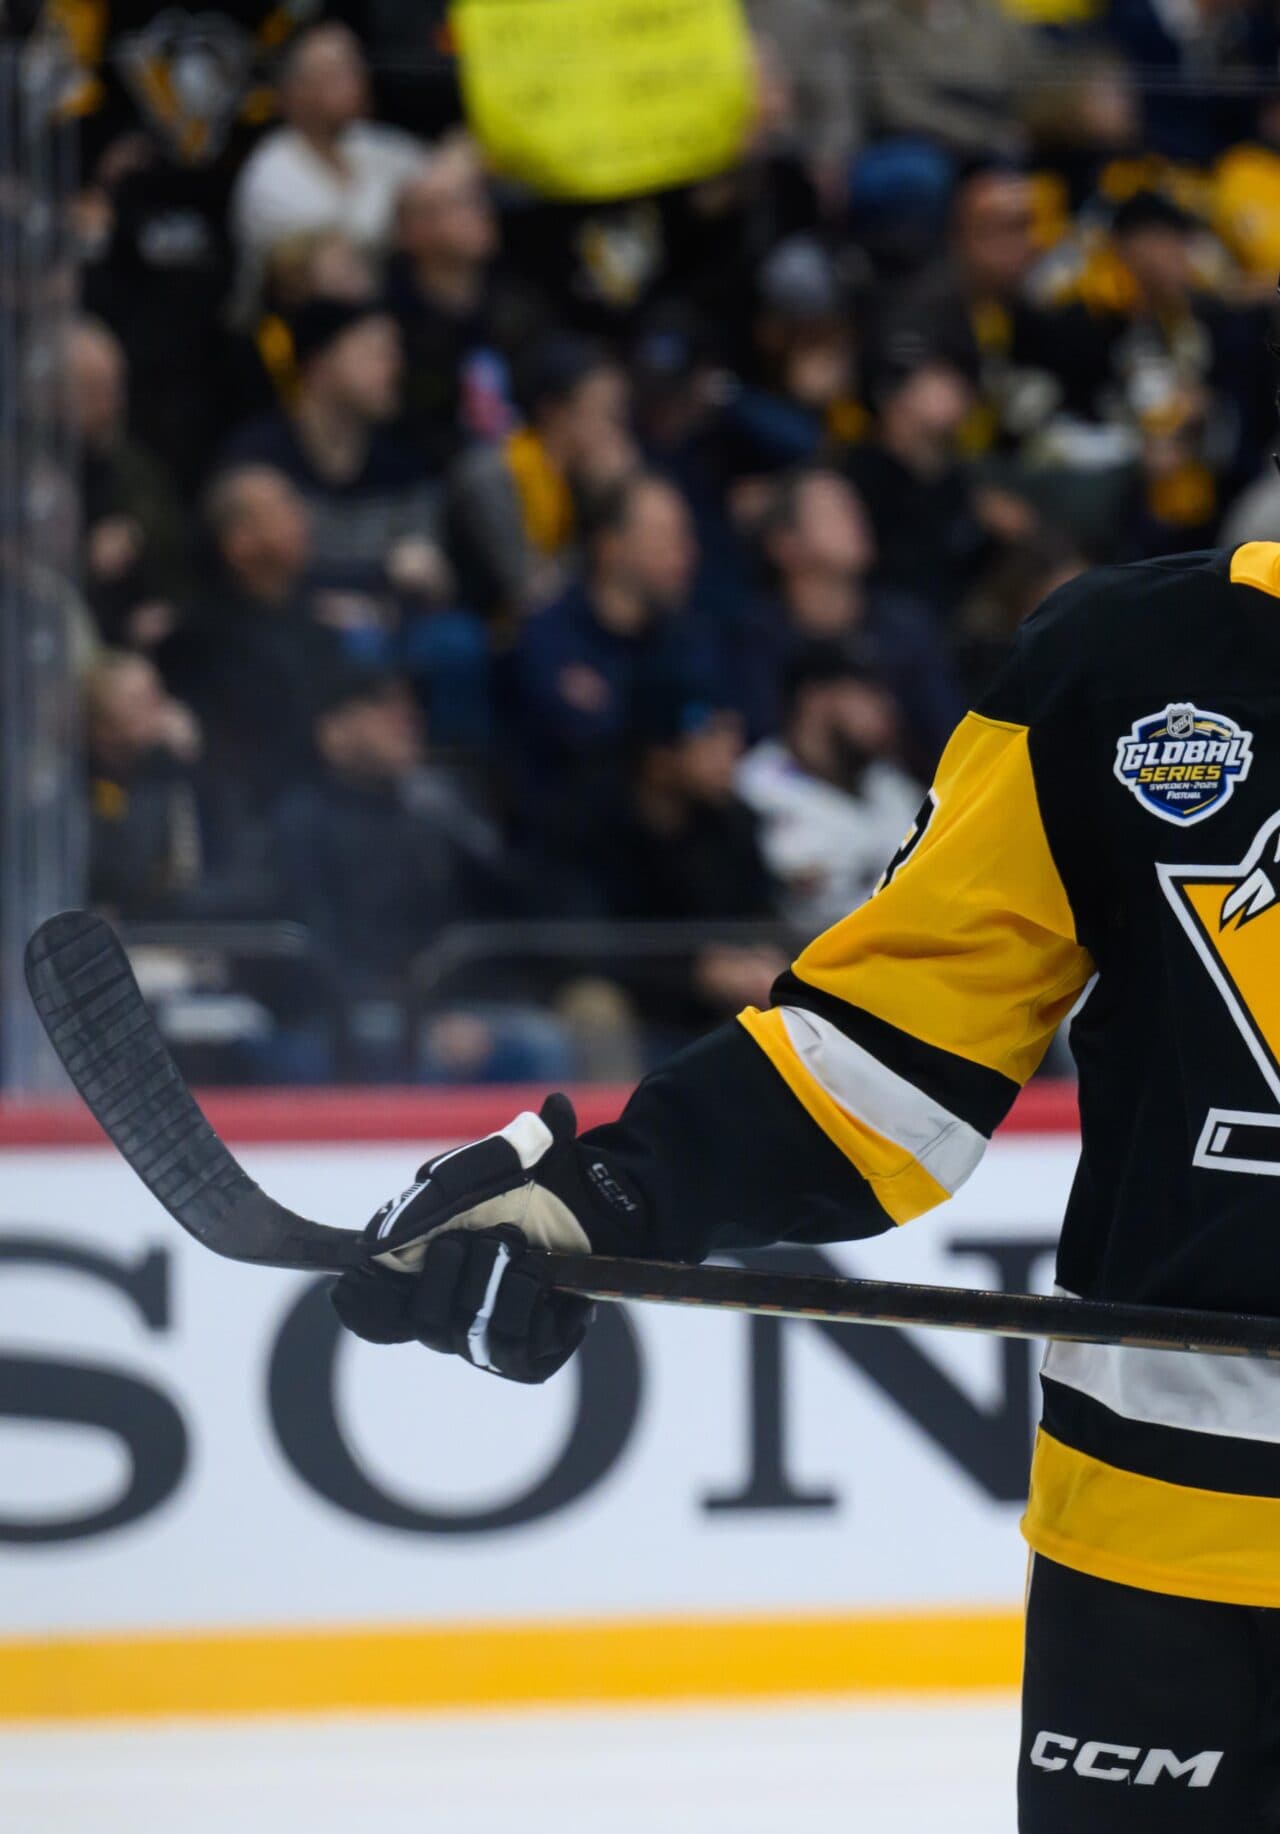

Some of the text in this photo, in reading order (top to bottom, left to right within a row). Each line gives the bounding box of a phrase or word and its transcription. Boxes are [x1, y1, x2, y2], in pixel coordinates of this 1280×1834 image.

[1121, 740, 1242, 771] GLOBAL
[1137, 765, 1222, 783] SERIES
[1030, 1731, 1224, 1787] CCM
